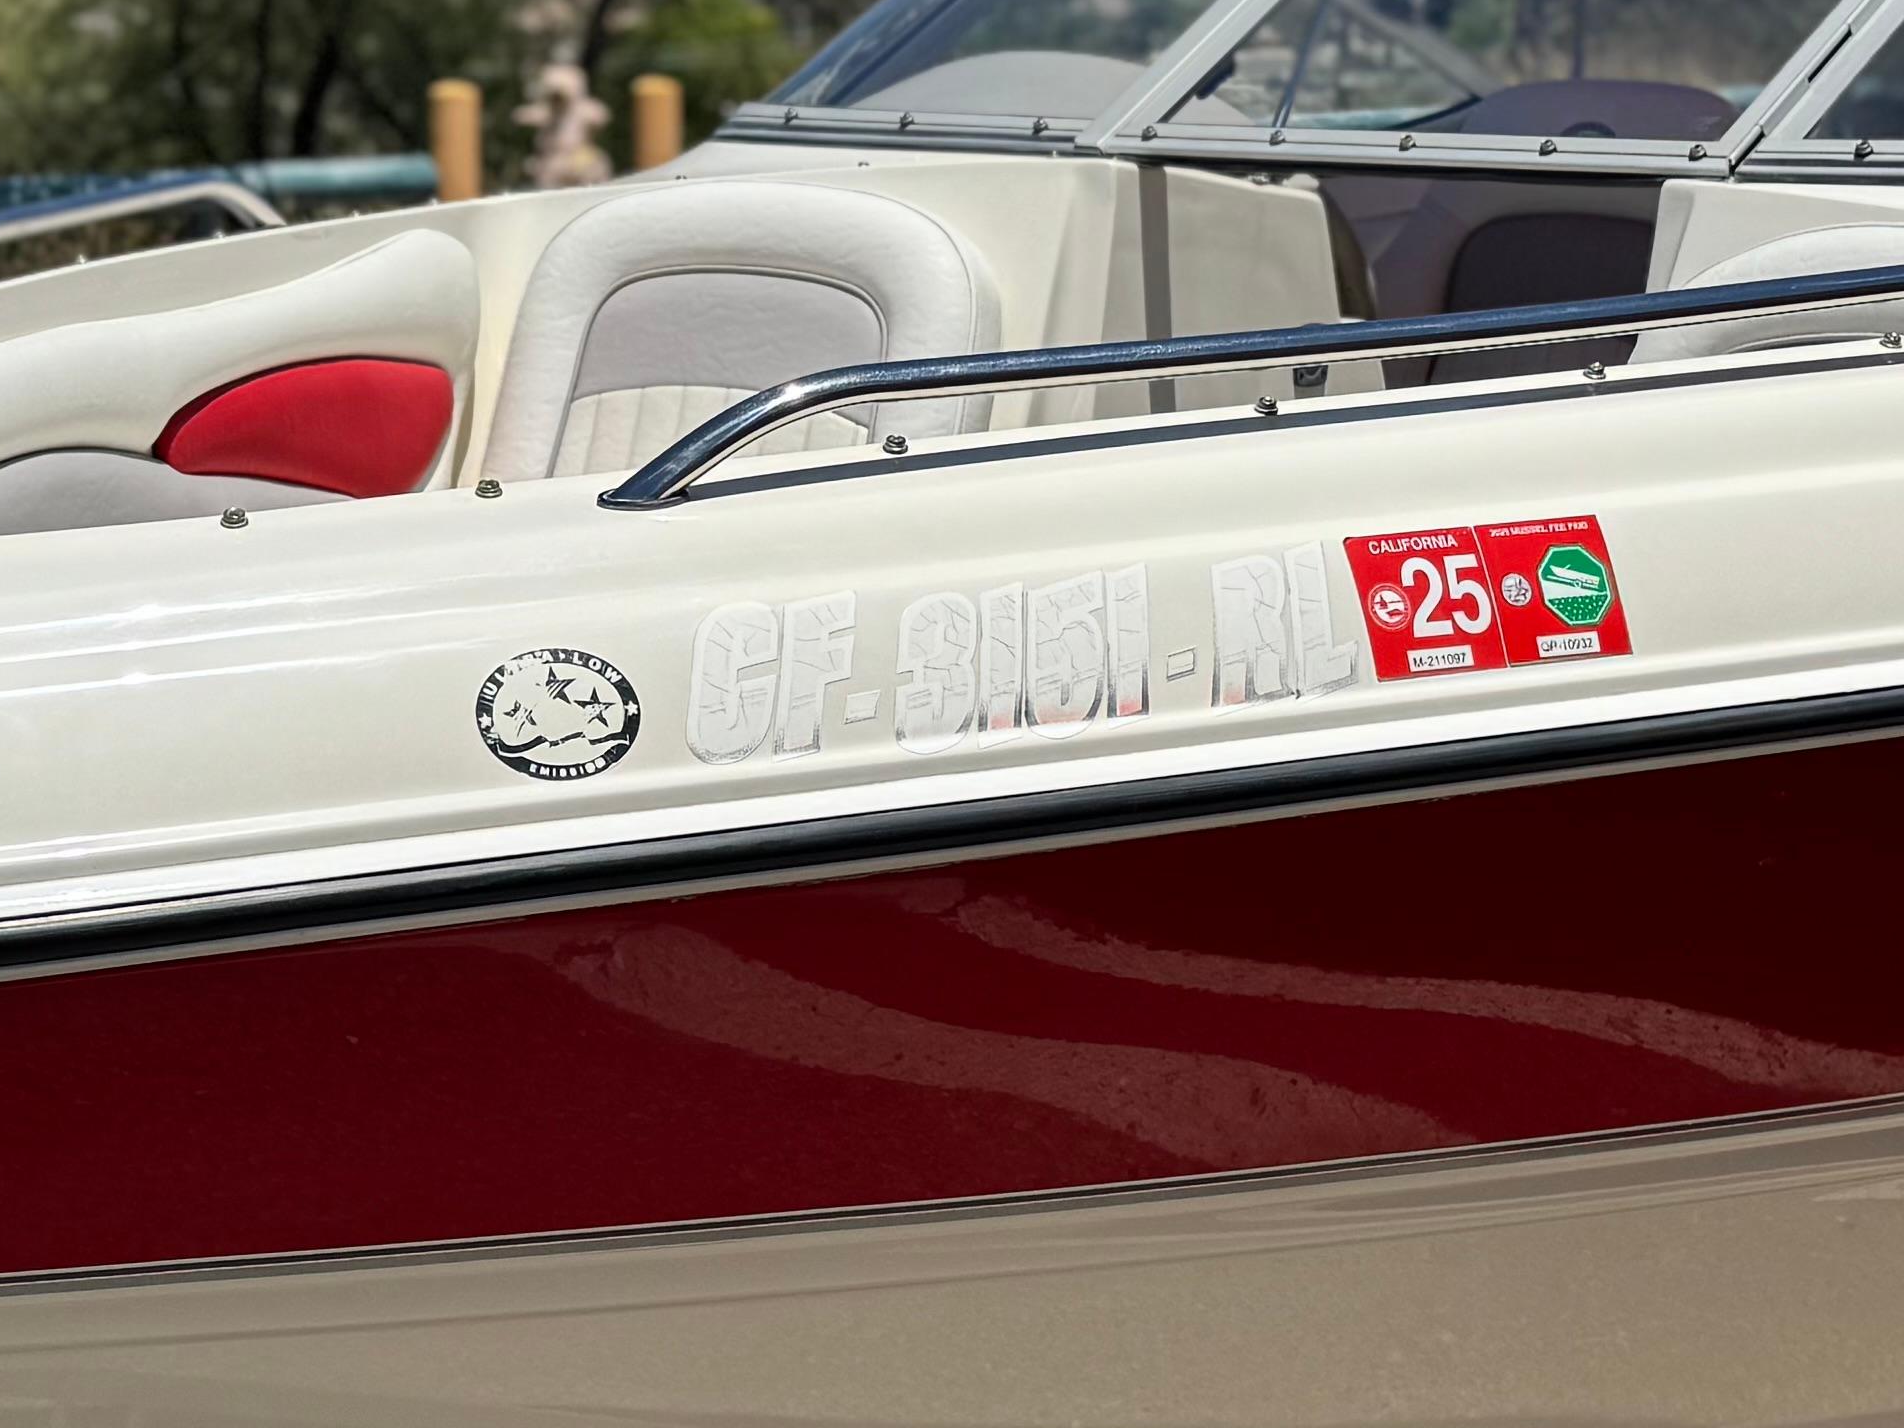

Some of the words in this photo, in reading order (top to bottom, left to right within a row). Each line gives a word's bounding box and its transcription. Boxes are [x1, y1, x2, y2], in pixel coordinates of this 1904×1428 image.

[1368, 534, 1458, 555] CALIFORNIA
[1400, 554, 1492, 638] 25
[571, 651, 623, 684] LOW
[1413, 652, 1467, 668] M-211097
